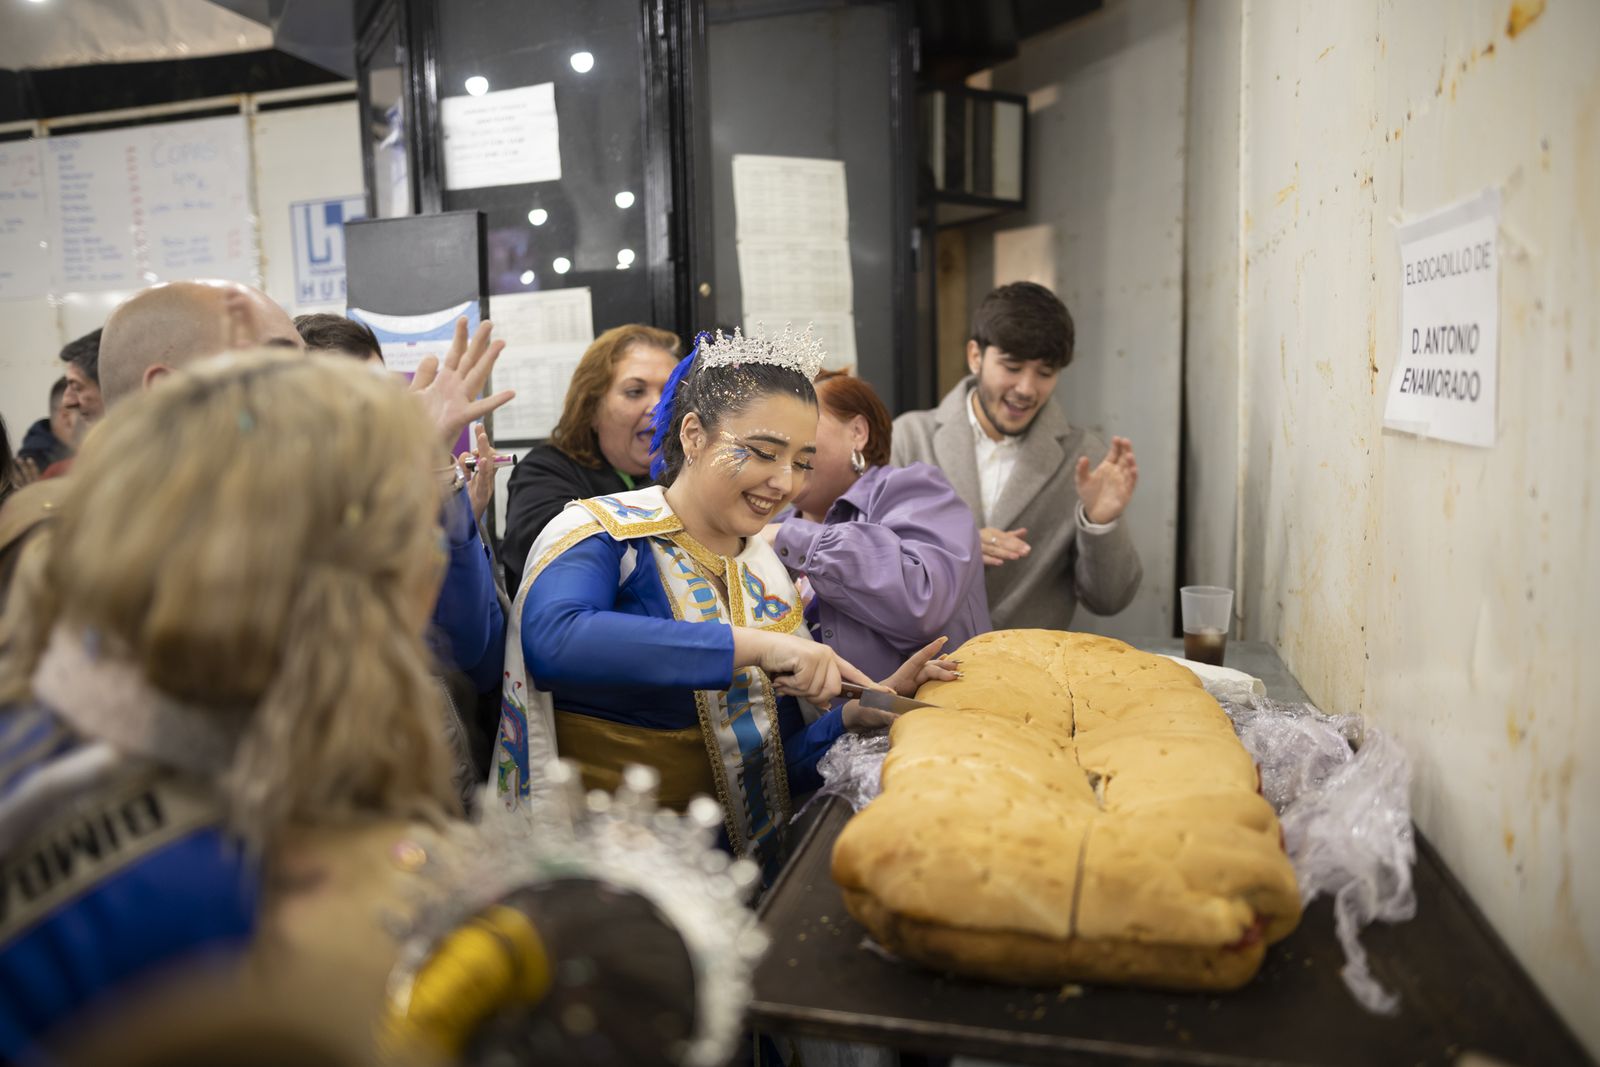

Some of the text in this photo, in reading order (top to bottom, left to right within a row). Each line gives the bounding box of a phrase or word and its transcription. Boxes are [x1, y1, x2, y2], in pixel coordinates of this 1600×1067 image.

[1406, 242, 1492, 285] EL BOCADILLO DE
[1412, 323, 1480, 355] D. ANTONIO
[1400, 368, 1481, 402] ENAMORADO
